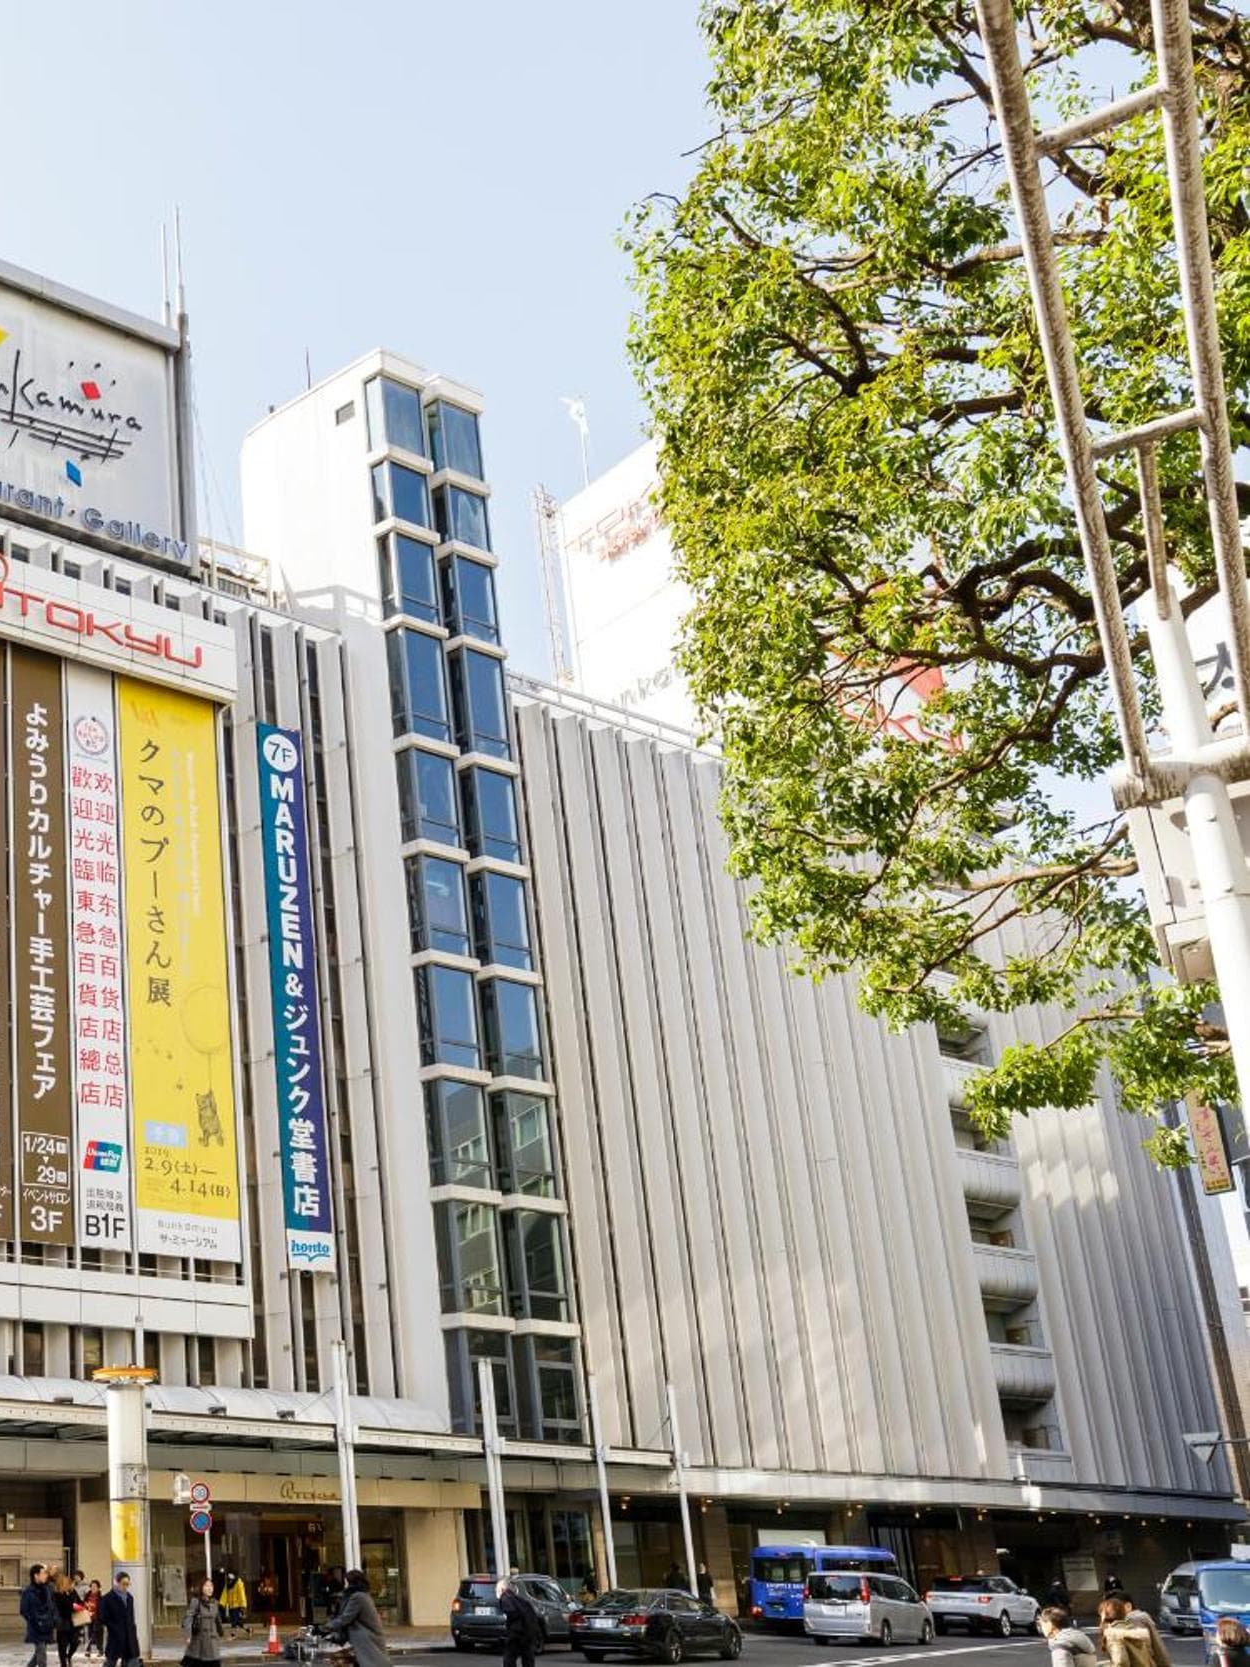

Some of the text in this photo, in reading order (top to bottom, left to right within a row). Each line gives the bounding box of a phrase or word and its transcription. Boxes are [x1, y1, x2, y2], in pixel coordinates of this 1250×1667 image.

[81, 508, 188, 560] Gallery
[3, 587, 202, 668] TOKYU
[268, 740, 293, 763] 7F
[137, 739, 171, 1007] クマのプーさん展
[25, 703, 56, 1100] よみうりカルチャー手工芸フェア
[30, 1205, 63, 1232] 3F
[85, 1213, 126, 1239] B1F
[291, 1240, 330, 1253] honto
